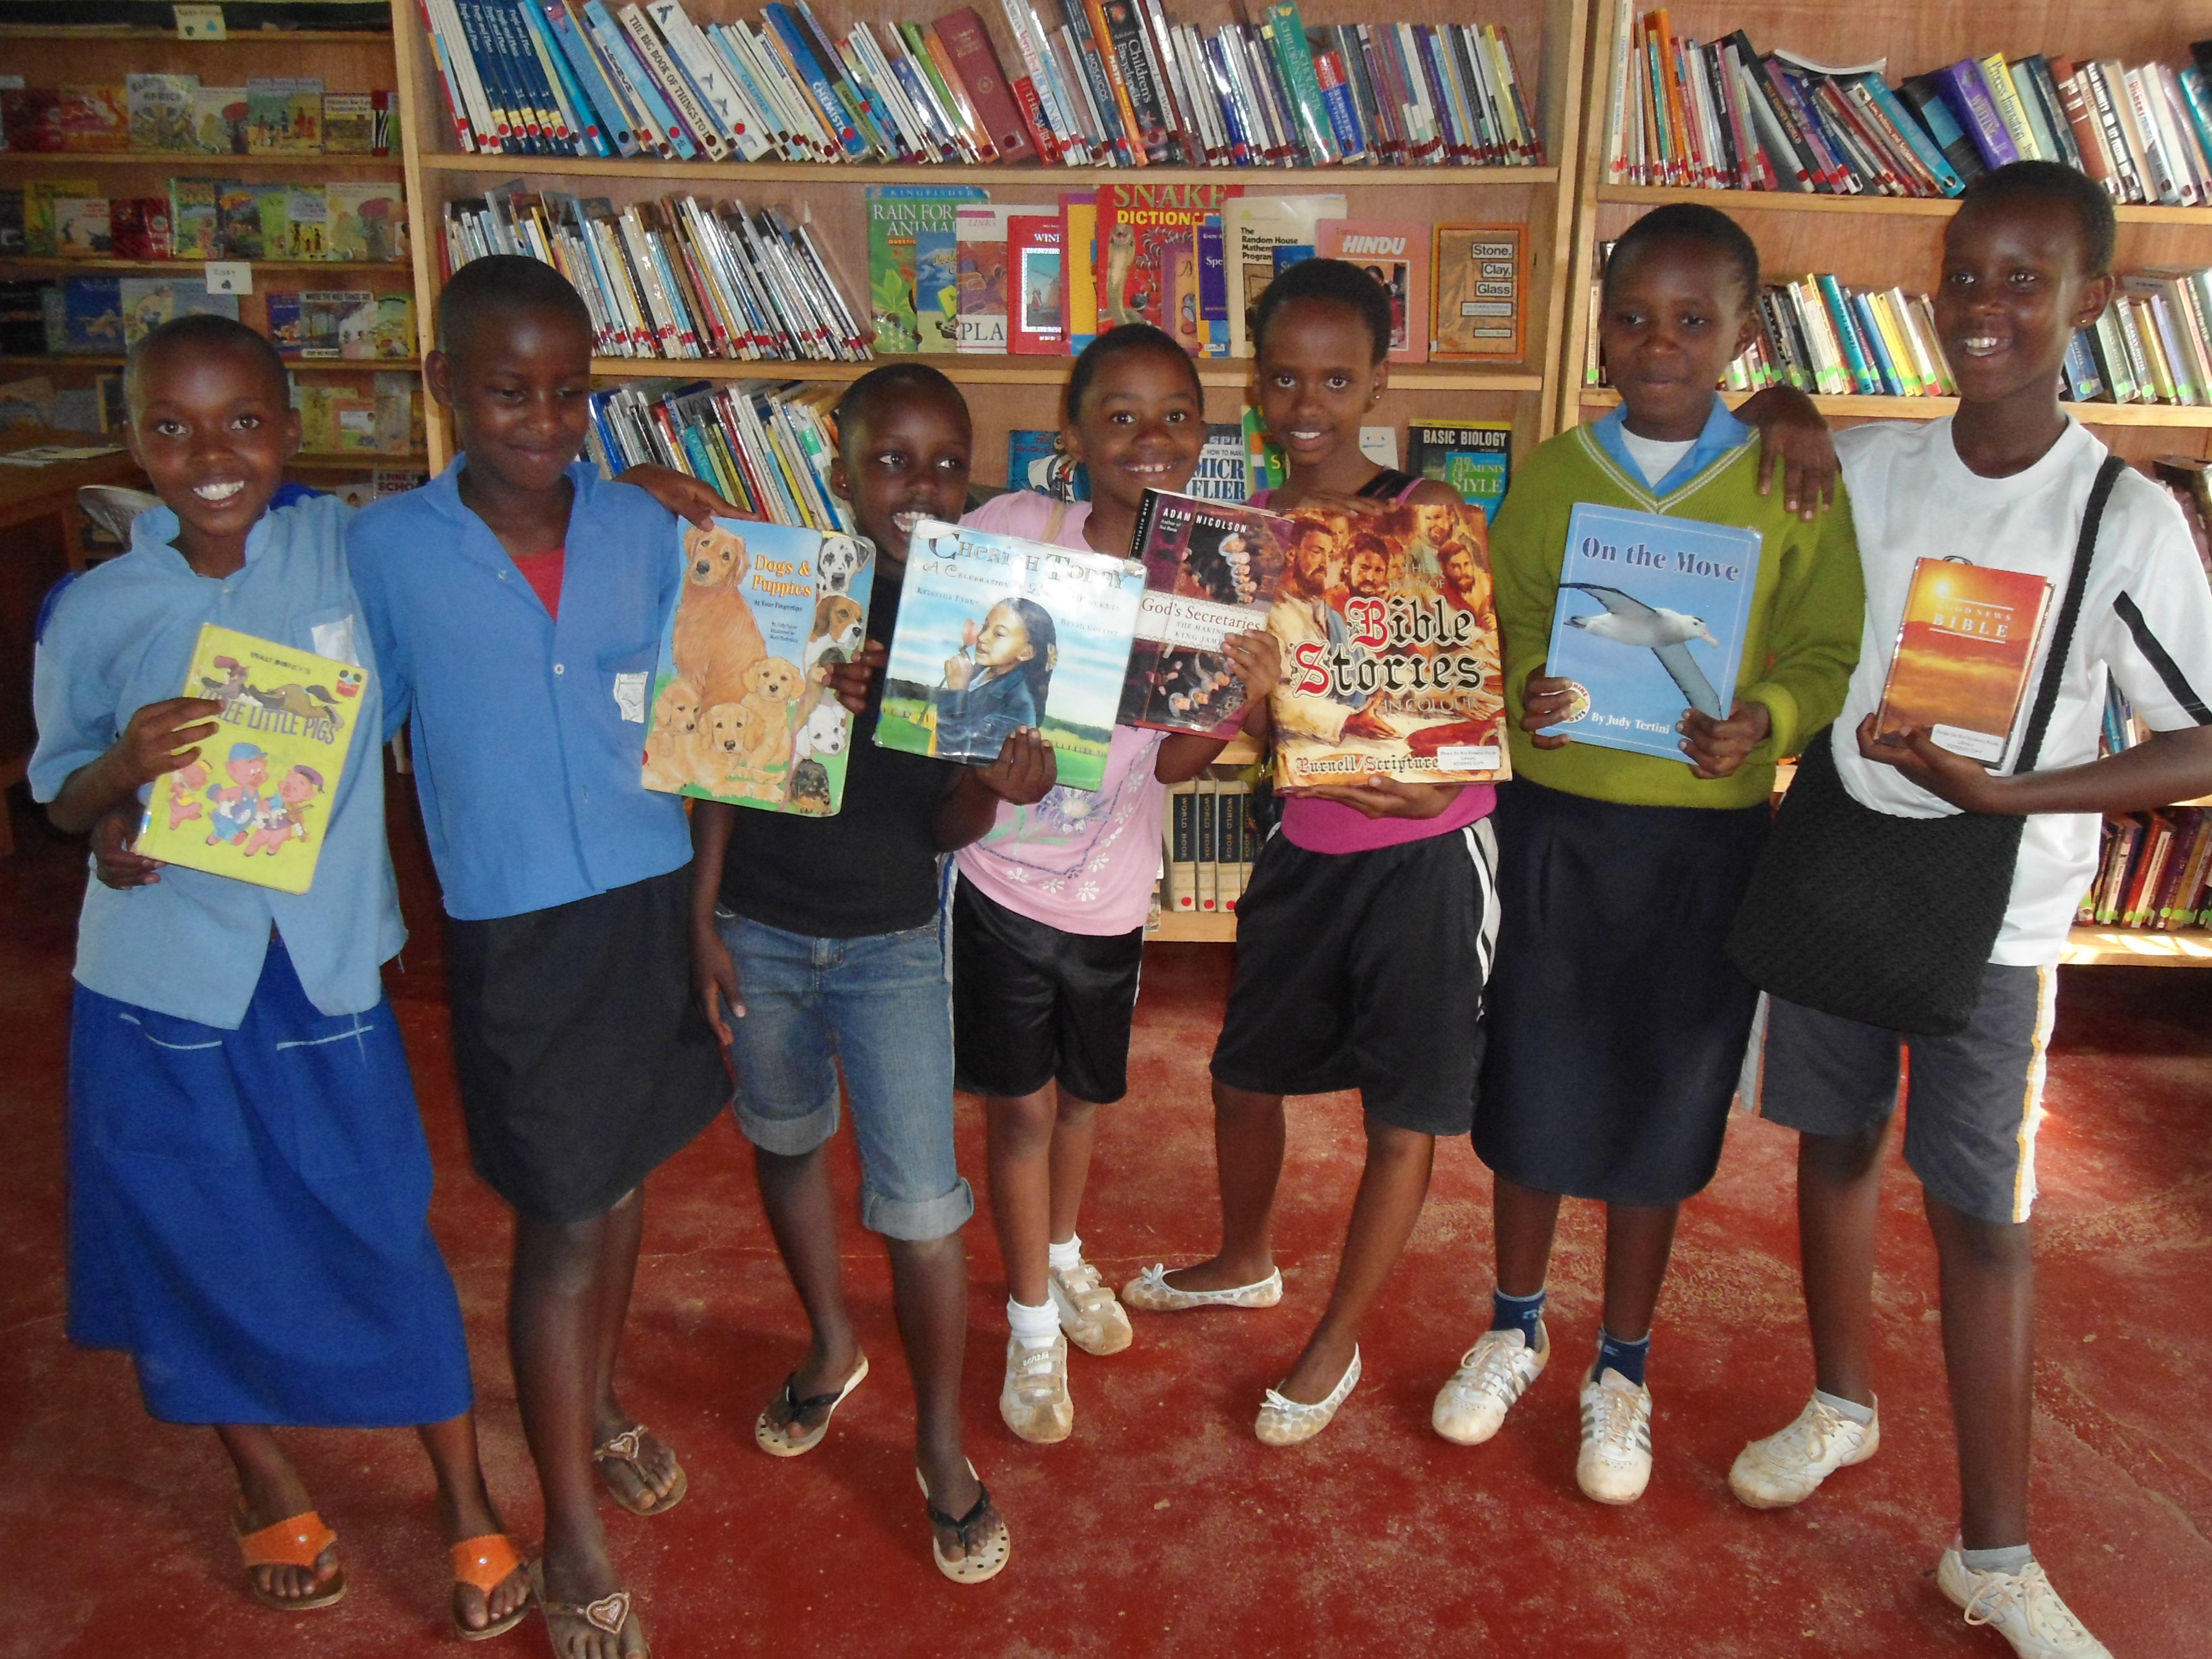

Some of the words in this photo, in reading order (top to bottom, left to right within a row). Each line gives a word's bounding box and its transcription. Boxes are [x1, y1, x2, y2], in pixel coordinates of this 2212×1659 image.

[628, 14, 646, 36] THE
[640, 33, 656, 51] BIG
[650, 48, 671, 76] BOOK
[665, 72, 680, 88] OF
[673, 85, 700, 121] THINGS
[693, 117, 707, 132] TO
[1106, 54, 1124, 86] MATH
[1111, 42, 1146, 108] Encyclopedia
[1122, 37, 1160, 105] Children's
[1139, 36, 1159, 72] Writing
[1151, 72, 1165, 93] Like
[1084, 52, 1110, 103] MOSAICOS
[1295, 48, 1325, 116] SCHOLASTIC
[1983, 59, 2018, 98] Process
[740, 72, 771, 117] COLUMBUS
[811, 80, 848, 135] CHEMISTR
[1761, 80, 1779, 100] WALT
[1770, 96, 1792, 122] DISNEY
[1782, 119, 1805, 146] WORLD
[1966, 93, 2002, 140] WRITING
[1994, 93, 2036, 143] Innovation
[1890, 131, 1903, 144] and
[1113, 184, 1228, 210] SNAKE
[873, 204, 916, 220] RAIN
[921, 204, 953, 220] FOR
[1242, 236, 1273, 244] Random
[1242, 244, 1272, 252] Mathem
[1342, 236, 1406, 255] HINDU
[1473, 244, 1512, 256] Stone,
[1206, 256, 1223, 268] Spe
[1484, 264, 1511, 276] Clay,
[1477, 283, 1511, 294] Glass
[1843, 324, 1859, 351] LADY!
[1423, 429, 1455, 445] BASIC
[1460, 431, 1507, 447] BIOLOGY
[686, 433, 709, 468] OCEAN
[1192, 458, 1244, 479] MICR
[1192, 479, 1245, 500] FLIER
[1453, 479, 1503, 494] STYLE
[1162, 508, 1192, 523] ADAM
[1196, 515, 1247, 534] NICOLSON
[755, 555, 794, 577] Dogs
[798, 560, 812, 576] &
[1403, 562, 1430, 574] THE
[1582, 536, 1617, 562] On
[1625, 544, 1667, 570] the
[1673, 551, 1740, 582] Move
[752, 575, 812, 598] Puppies
[917, 587, 953, 602] Kristina
[1389, 579, 1423, 590] BOOK
[1427, 578, 1445, 589] OF
[775, 602, 802, 612] Fingertips
[1142, 598, 1181, 617] God's
[1186, 606, 1261, 632] Secretaries
[1977, 609, 2012, 622] NEWS
[1061, 618, 1086, 630] Bryan
[1176, 621, 1191, 630] THE
[1194, 624, 1227, 636] MAKING
[1348, 596, 1472, 650] Bible
[1932, 613, 2009, 638] BIBLE
[1175, 632, 1198, 641] KING
[251, 651, 273, 664] WALT
[274, 659, 311, 675] DISNEY'S
[1294, 642, 1482, 696] Stories
[1383, 699, 1402, 712] IN
[1409, 696, 1479, 712] COLOUR
[248, 701, 299, 736] LITTLE
[303, 717, 336, 745] PIGS
[1592, 712, 1606, 726] By
[1606, 714, 1632, 729] Judy
[1635, 719, 1670, 734] Tertini
